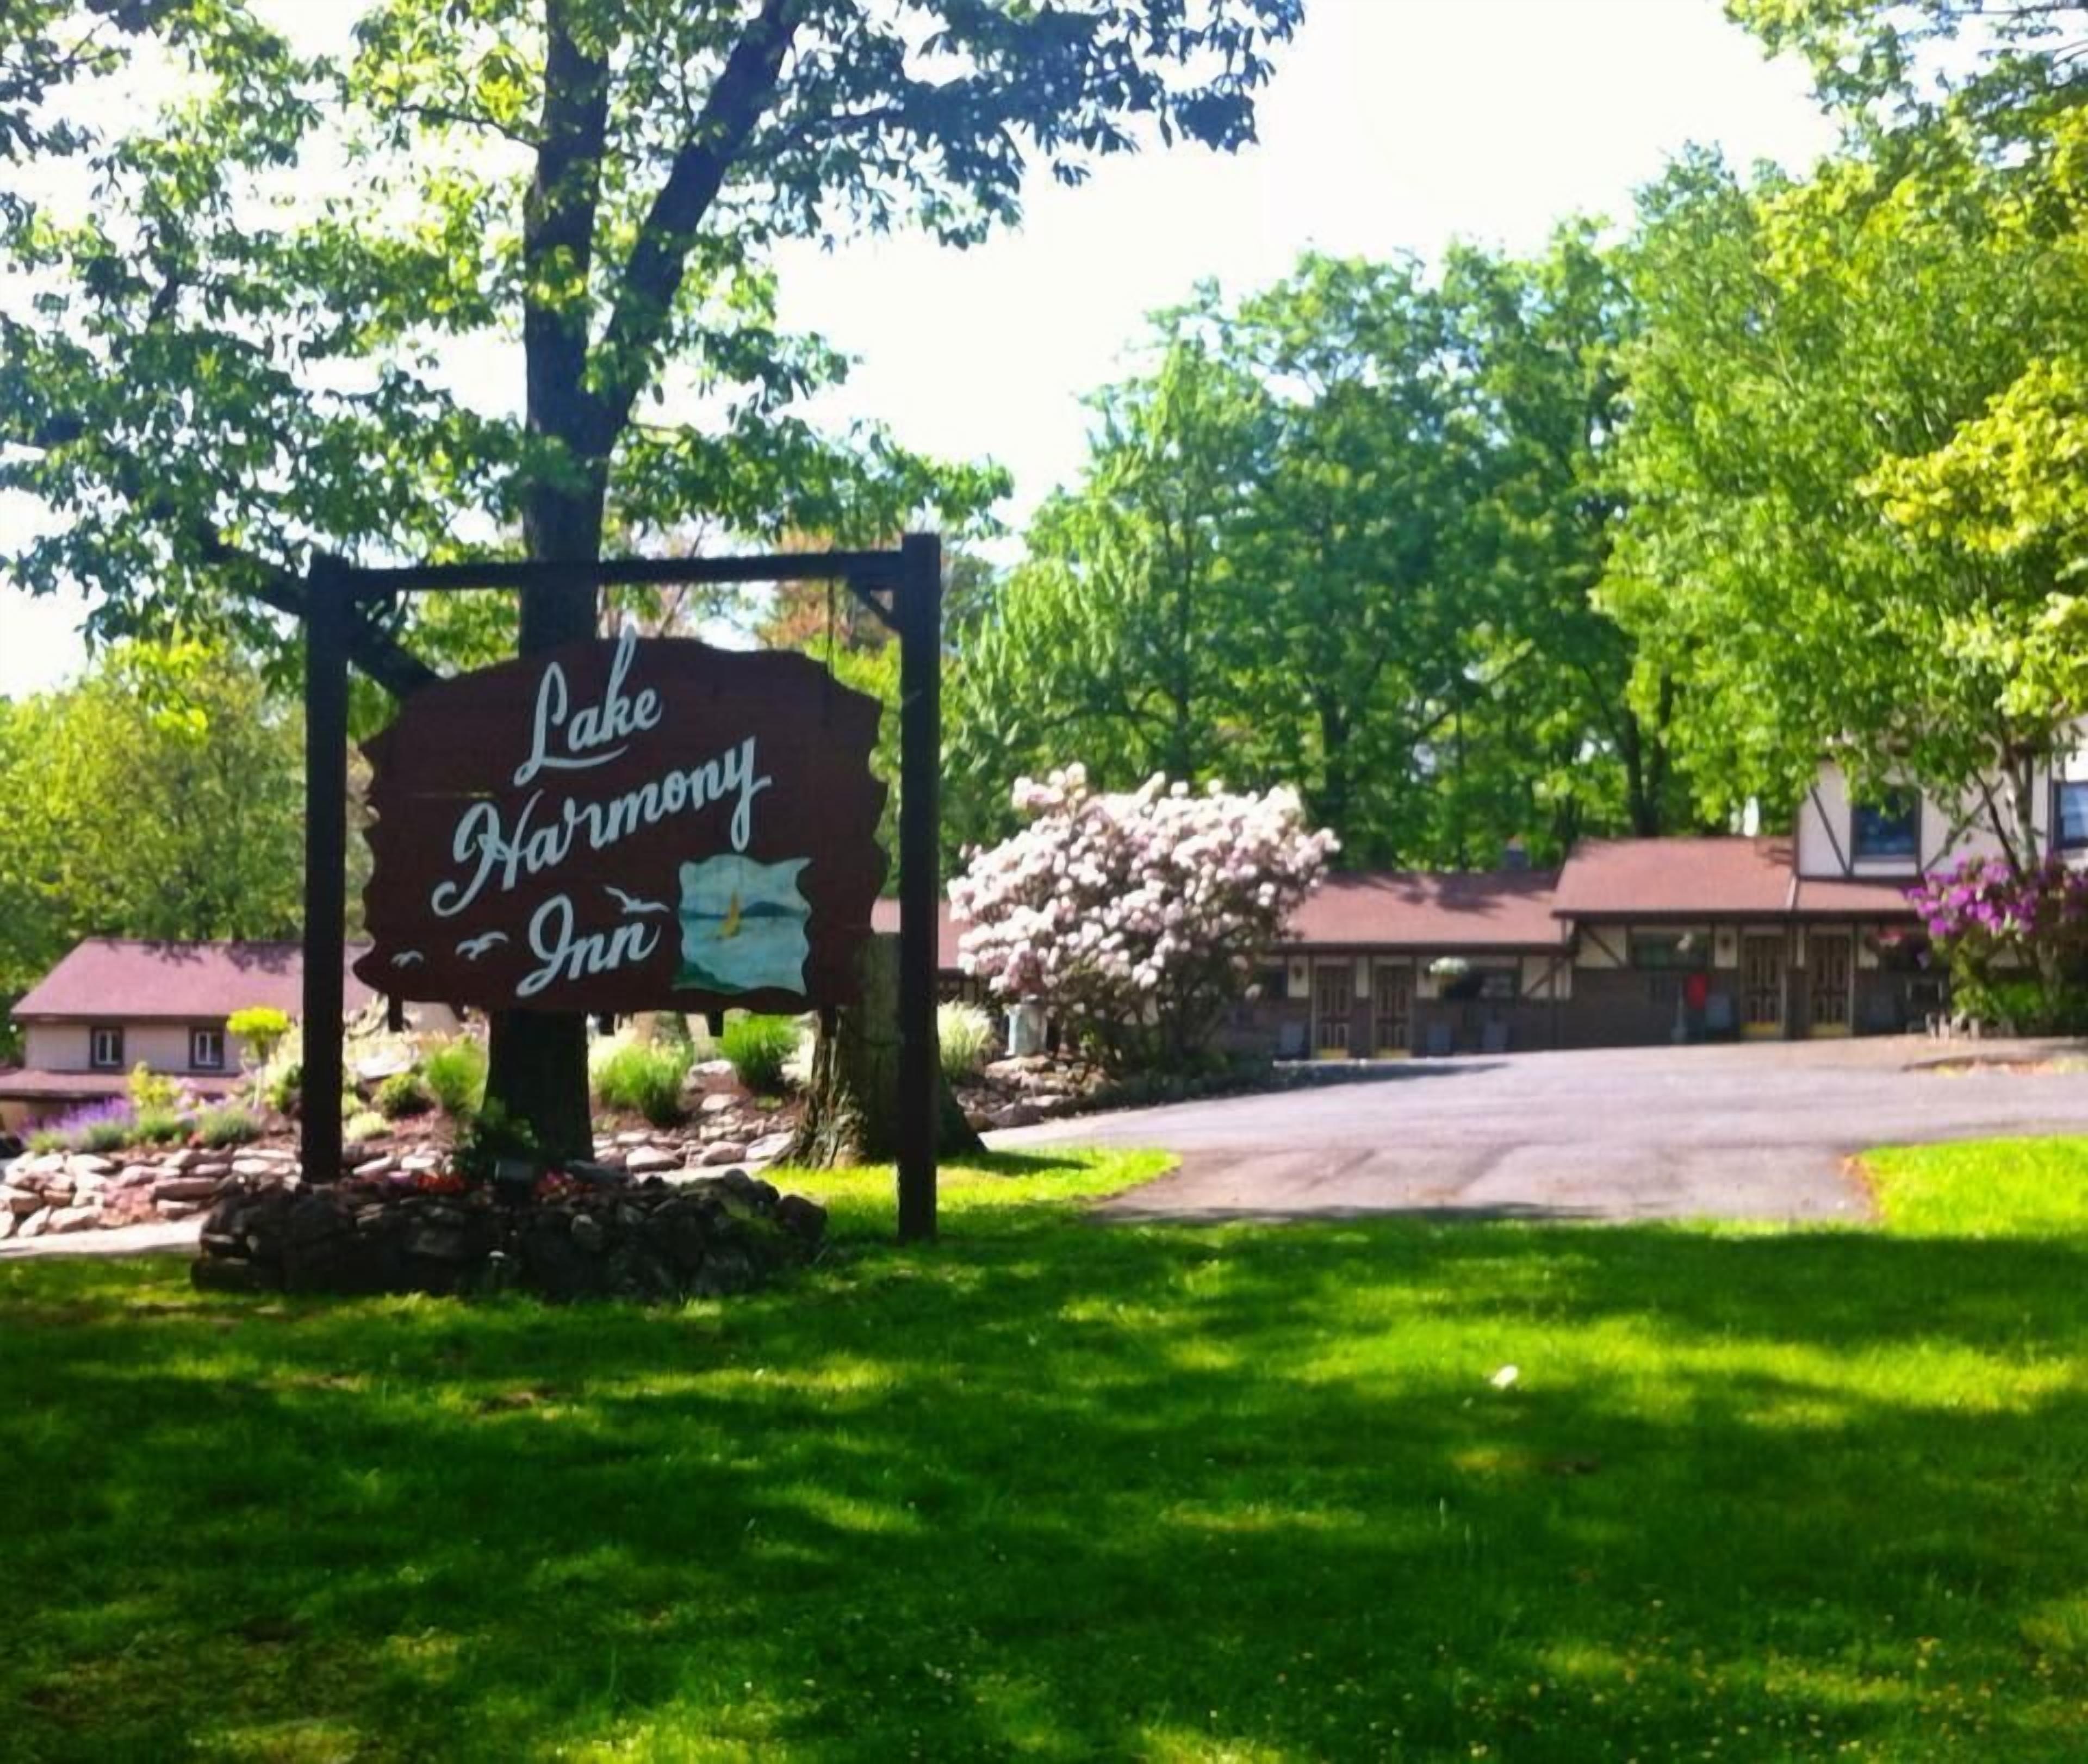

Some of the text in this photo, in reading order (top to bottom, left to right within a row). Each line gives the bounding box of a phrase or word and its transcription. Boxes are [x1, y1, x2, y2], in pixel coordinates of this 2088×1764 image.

[514, 624, 663, 787] Lake
[431, 736, 772, 917] Harmony
[516, 893, 663, 998] Inn
